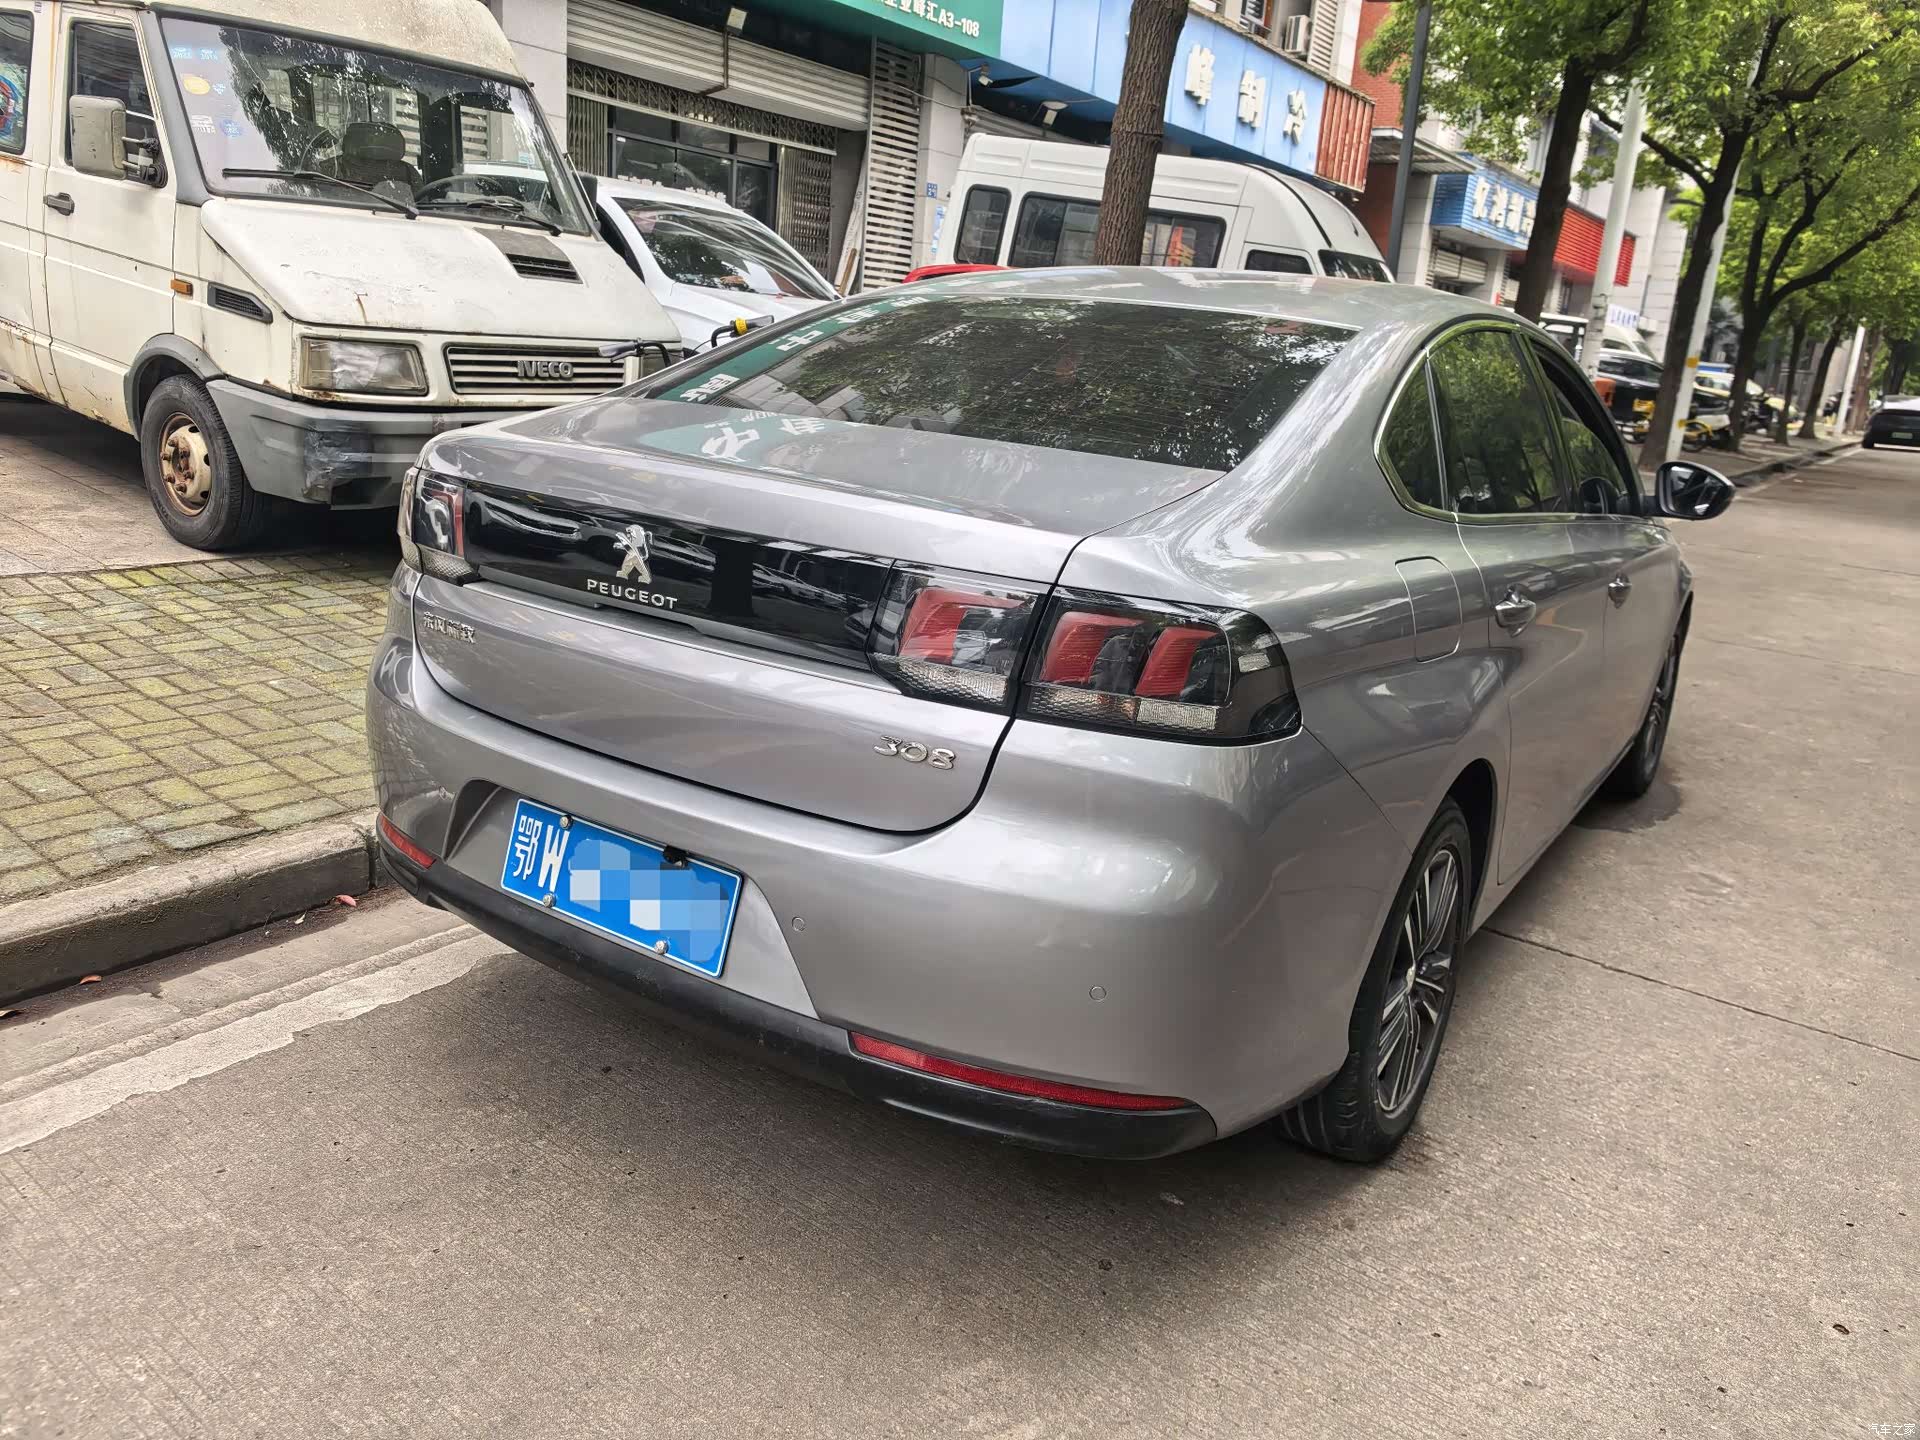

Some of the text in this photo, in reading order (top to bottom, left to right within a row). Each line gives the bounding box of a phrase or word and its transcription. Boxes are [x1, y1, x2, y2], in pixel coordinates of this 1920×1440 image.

[517, 359, 574, 378] IVECO
[587, 579, 678, 610] PEUGEOT
[873, 735, 955, 770] 308
